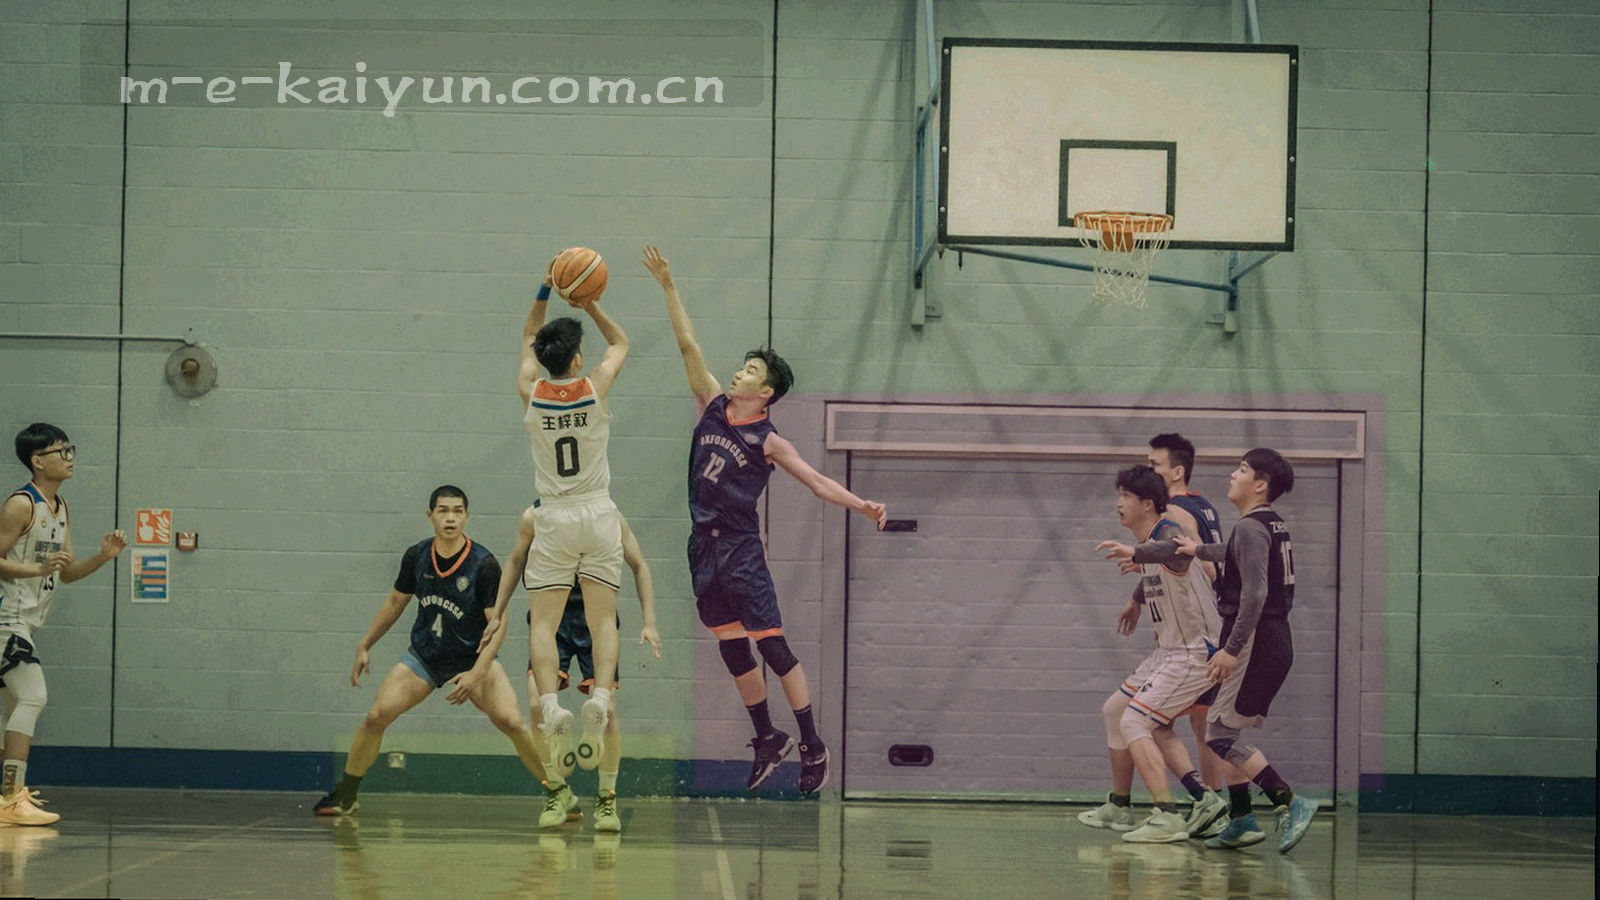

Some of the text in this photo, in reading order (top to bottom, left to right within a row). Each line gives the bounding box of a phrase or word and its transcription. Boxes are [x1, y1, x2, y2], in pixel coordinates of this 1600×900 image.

[555, 436, 580, 477] 0
[702, 451, 726, 484] 12
[431, 613, 443, 638] 4
